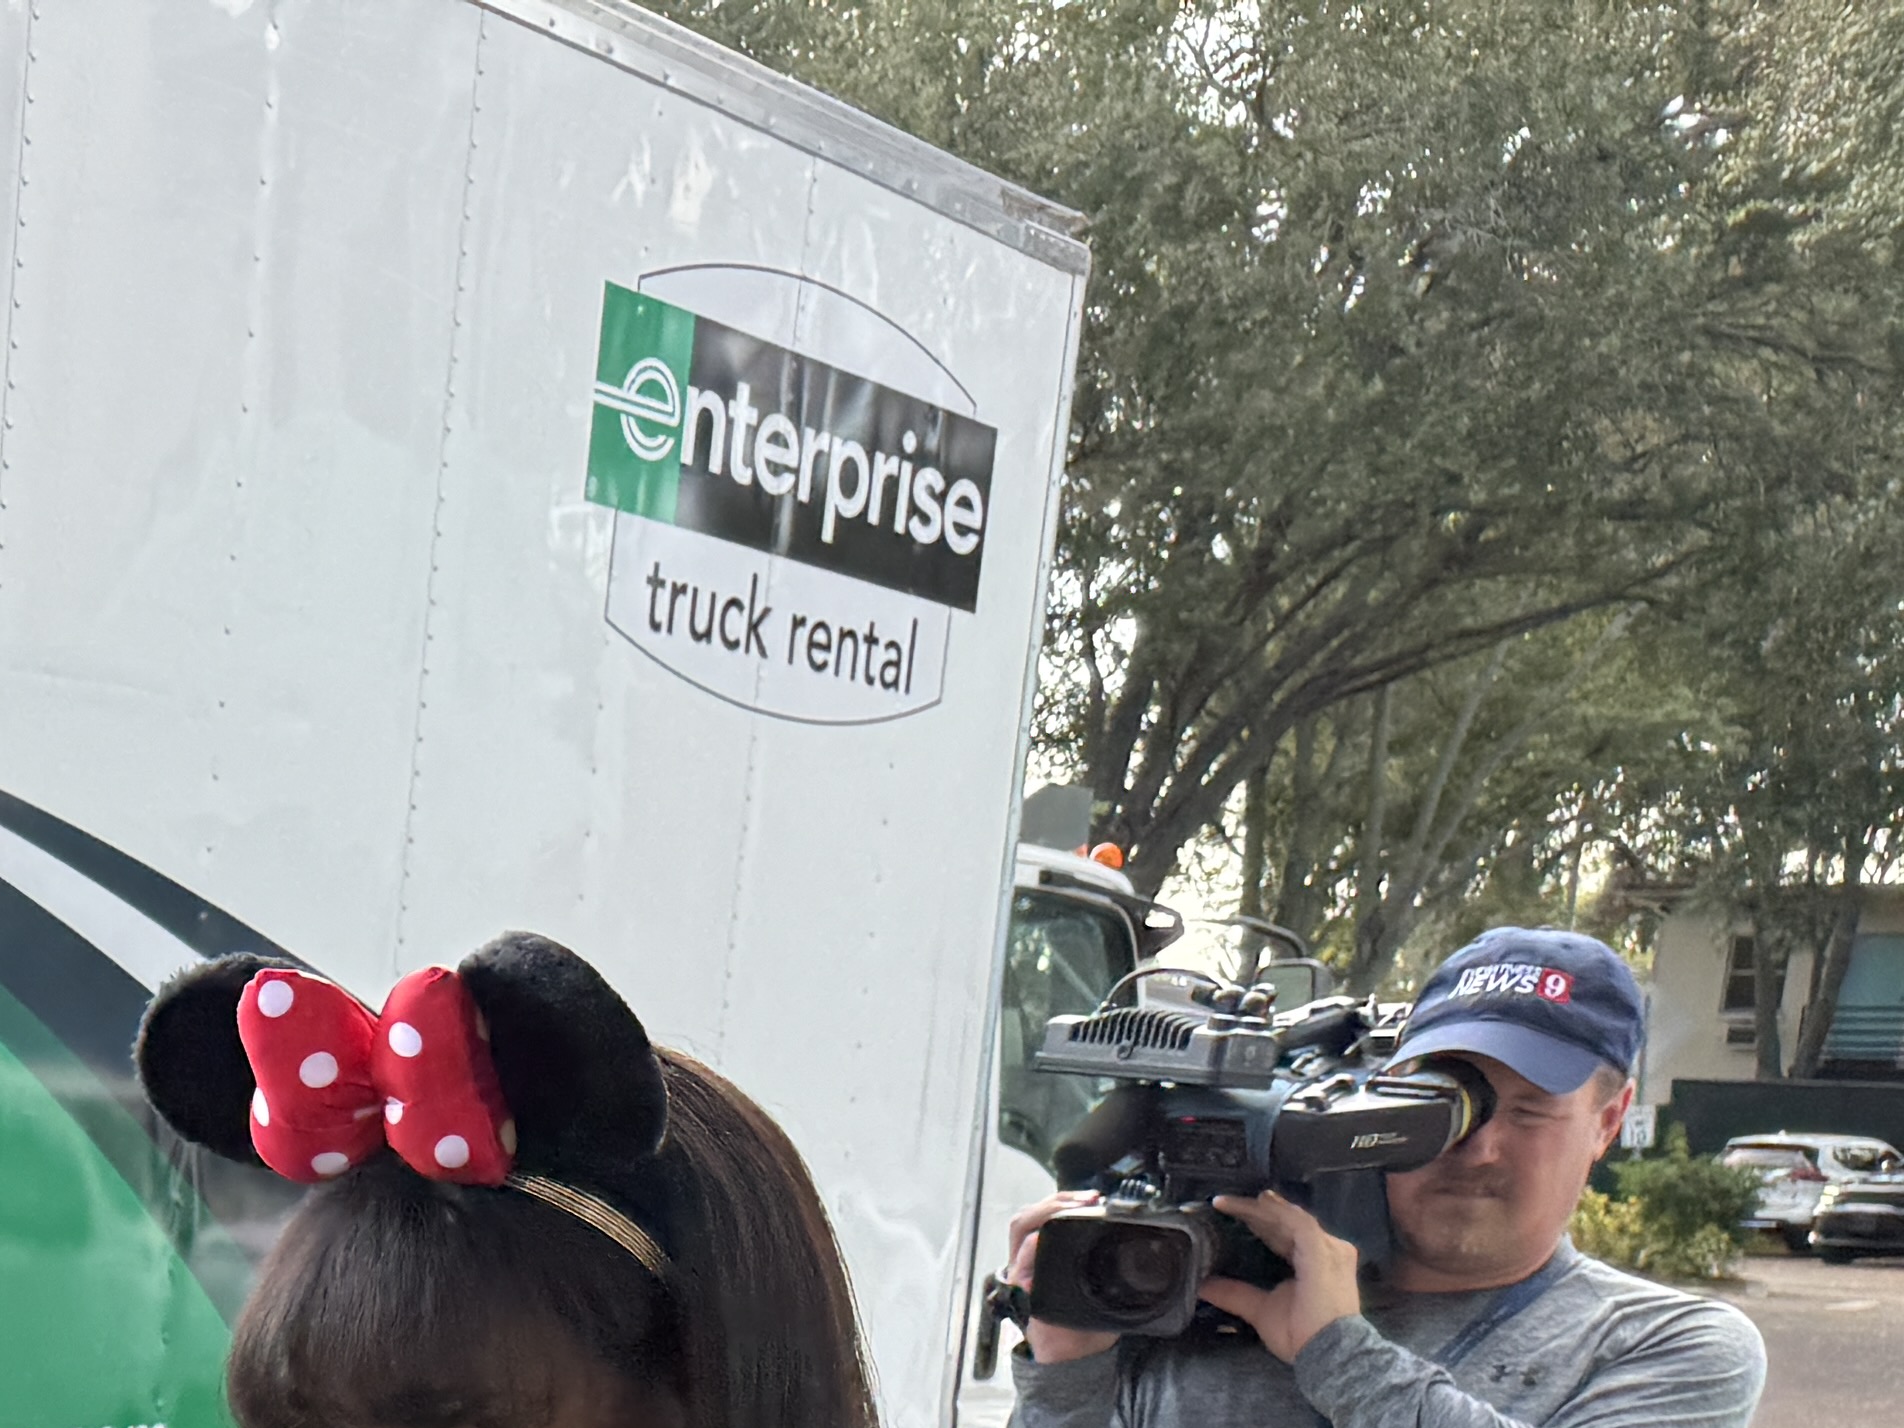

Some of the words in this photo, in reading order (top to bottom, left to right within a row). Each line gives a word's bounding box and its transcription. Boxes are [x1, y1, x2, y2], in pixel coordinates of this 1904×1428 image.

[594, 356, 985, 556] enterprise
[645, 562, 770, 661] truck
[788, 616, 919, 696] rental
[1447, 972, 1540, 1000] NEWS
[1544, 973, 1567, 999] 9
